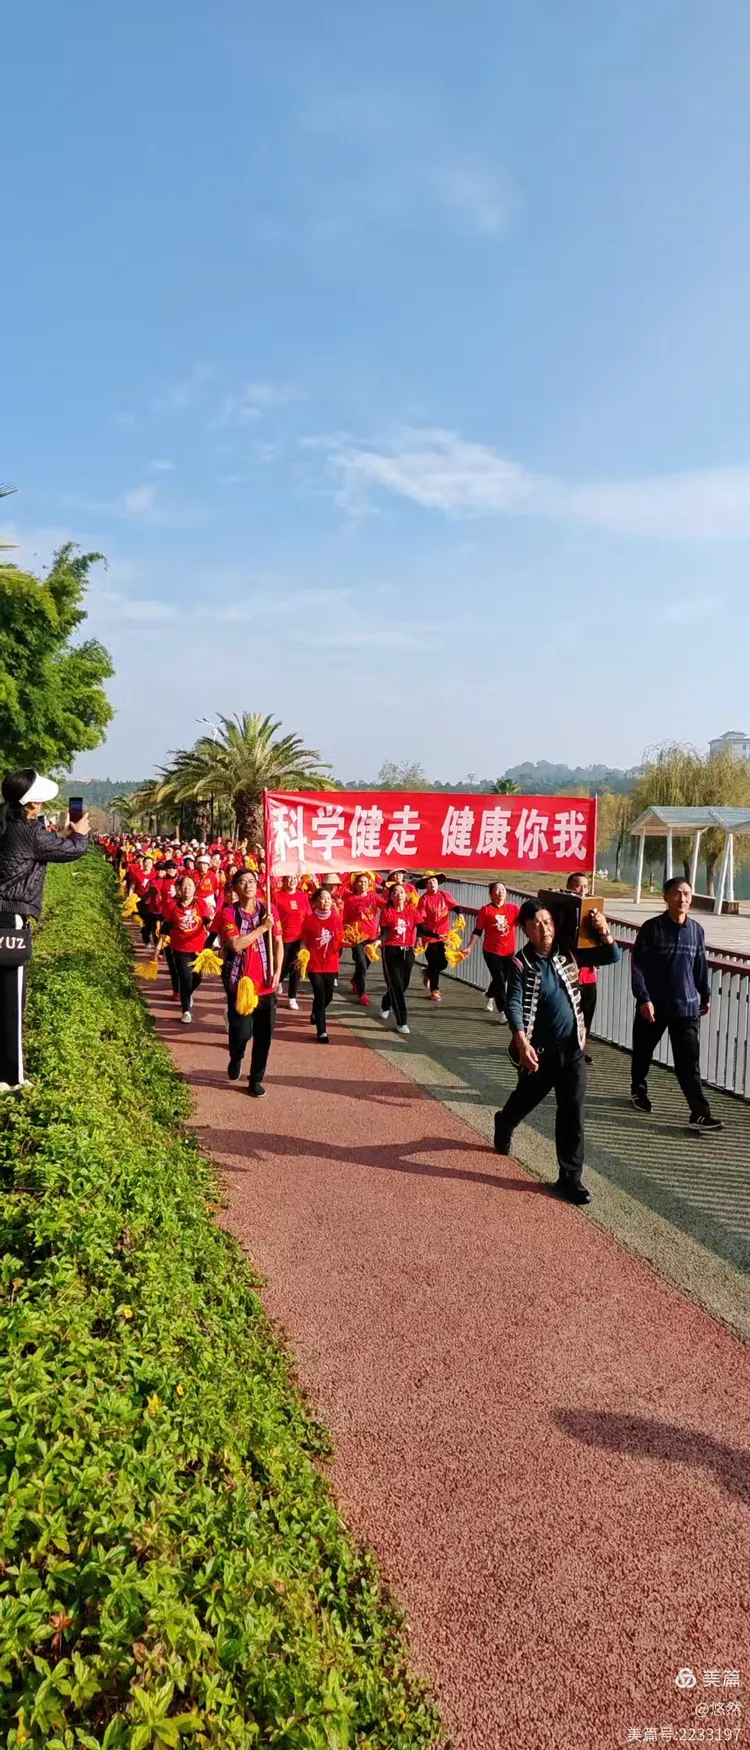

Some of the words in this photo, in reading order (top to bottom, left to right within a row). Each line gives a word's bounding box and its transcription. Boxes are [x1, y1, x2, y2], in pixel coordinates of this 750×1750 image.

[272, 804, 421, 861] 科学健走
[441, 805, 588, 860] 健康你我
